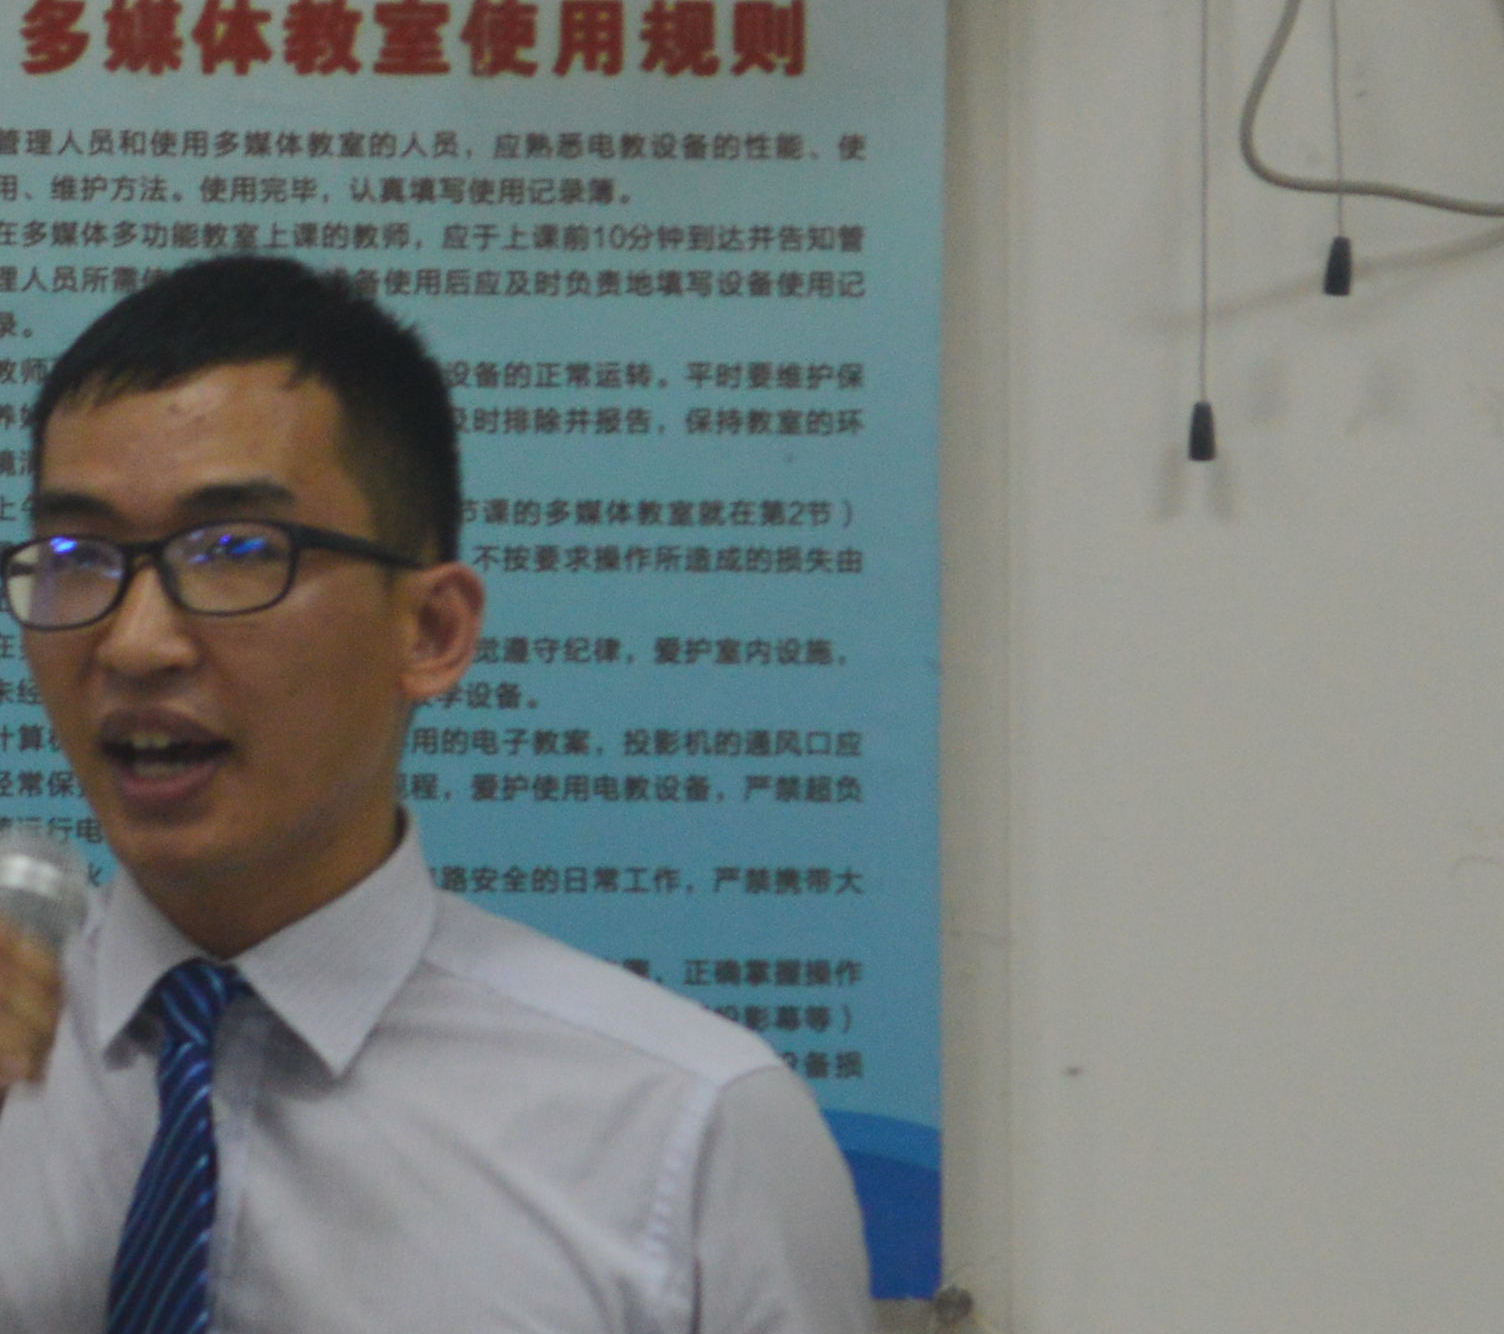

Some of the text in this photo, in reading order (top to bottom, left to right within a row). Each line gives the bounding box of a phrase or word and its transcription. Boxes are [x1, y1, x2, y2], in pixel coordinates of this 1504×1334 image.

[334, 268, 866, 298] 备使用后应及时负责地填写设备使用记
[429, 865, 865, 896] 路安全的日常工作，严禁携带大
